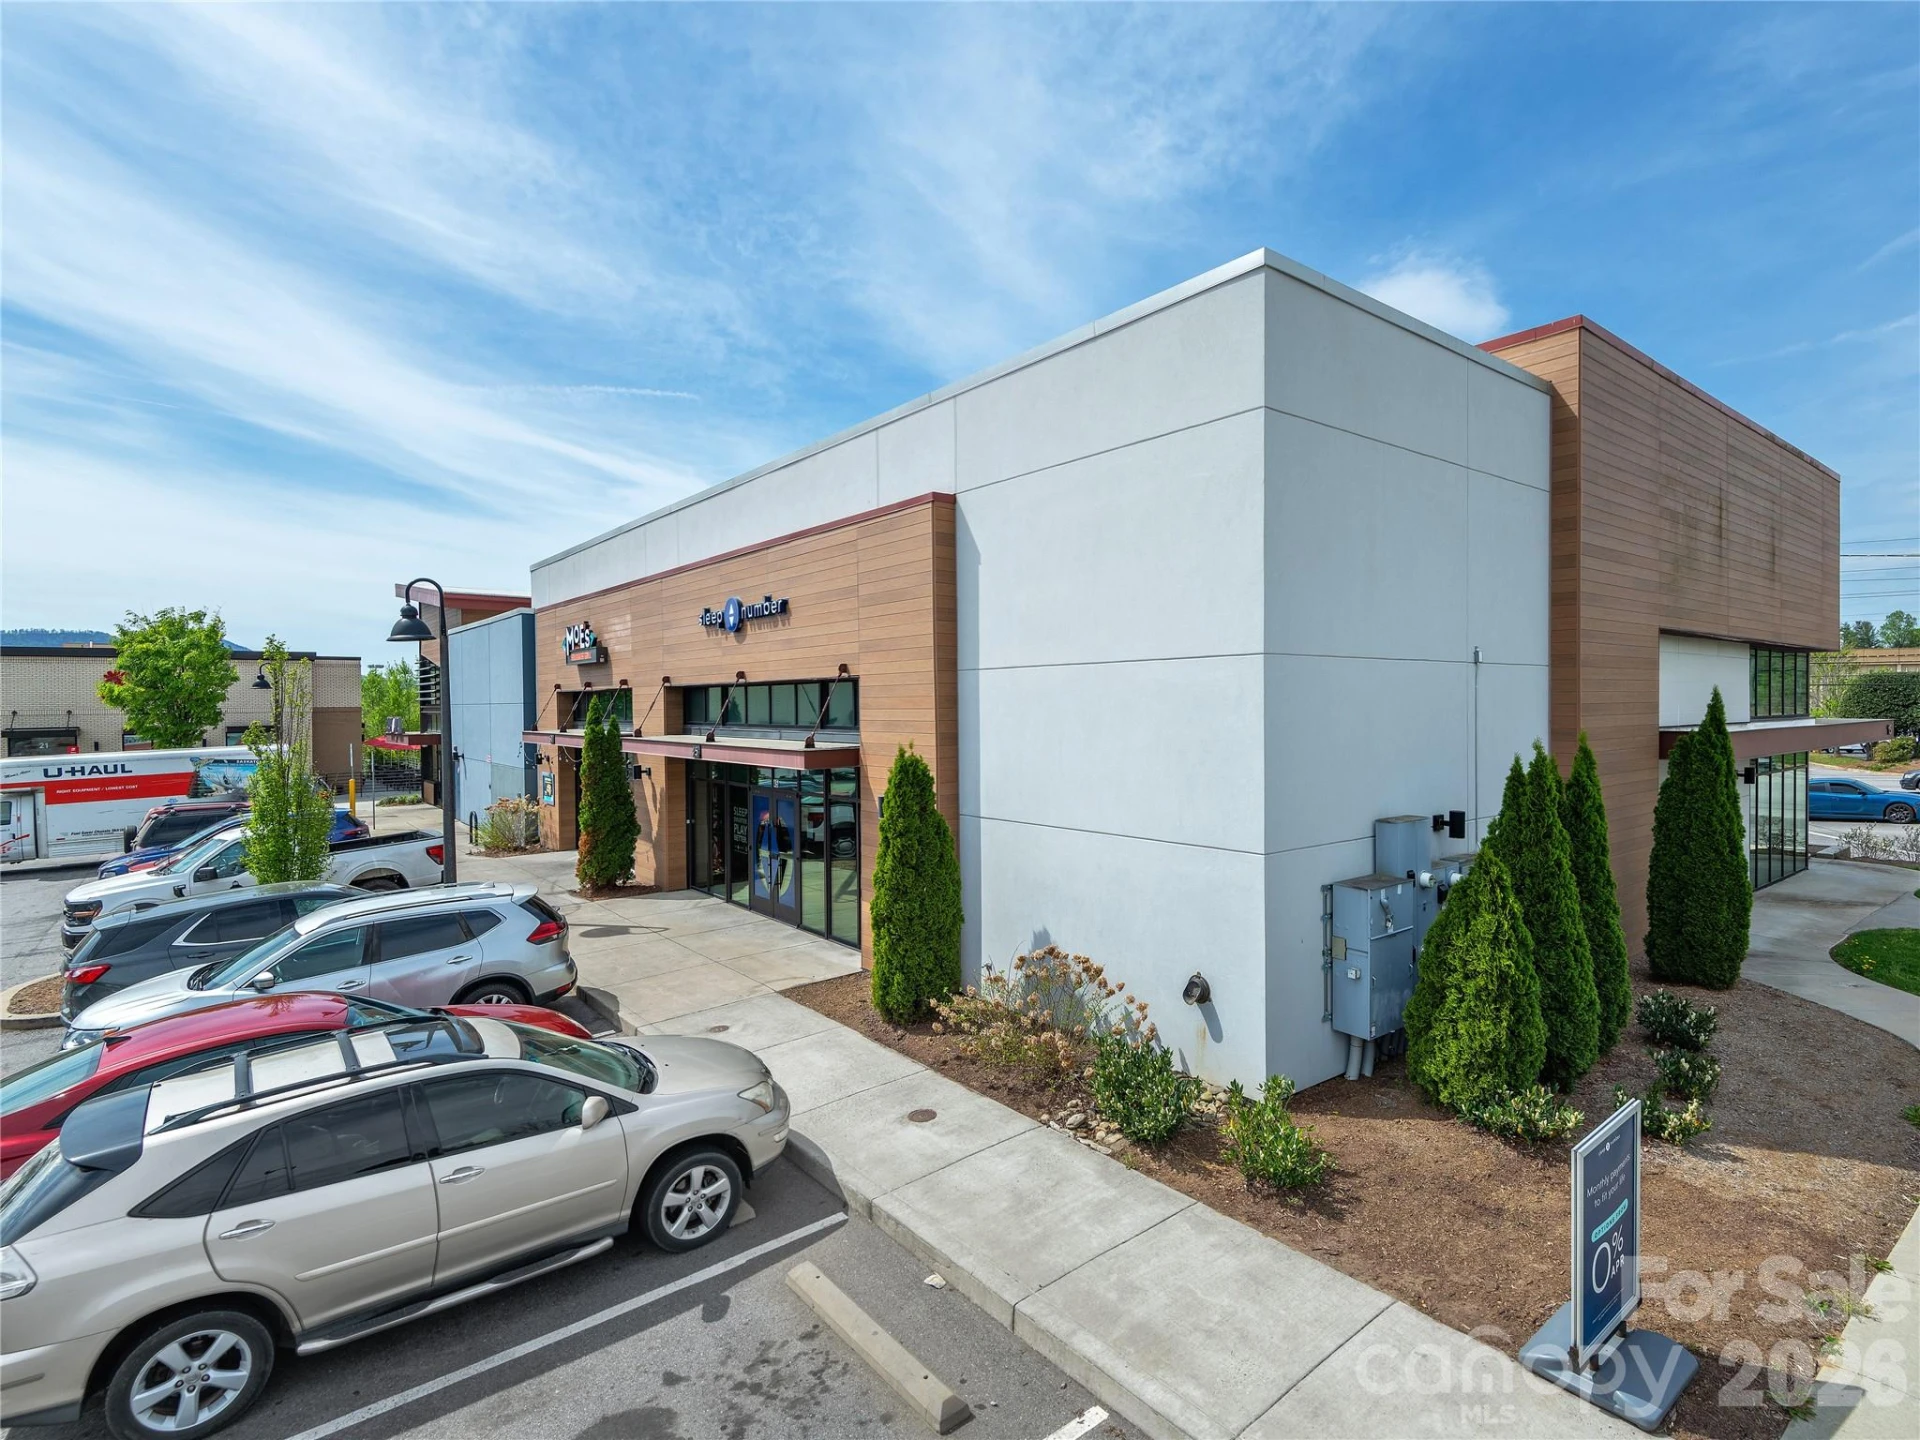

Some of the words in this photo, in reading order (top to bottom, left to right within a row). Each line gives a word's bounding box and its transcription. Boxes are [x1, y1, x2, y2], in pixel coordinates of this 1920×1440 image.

[698, 607, 725, 629] sleep
[741, 594, 790, 620] number
[43, 763, 133, 779] U-HAUL
[733, 823, 748, 836] PLAY
[1586, 1174, 1610, 1198] Monthly
[1610, 1153, 1631, 1182] payments
[1594, 1198, 1601, 1208] to
[1608, 1181, 1619, 1200] your
[1594, 1217, 1615, 1239] OPTIONS
[1611, 1253, 1625, 1279] APR
